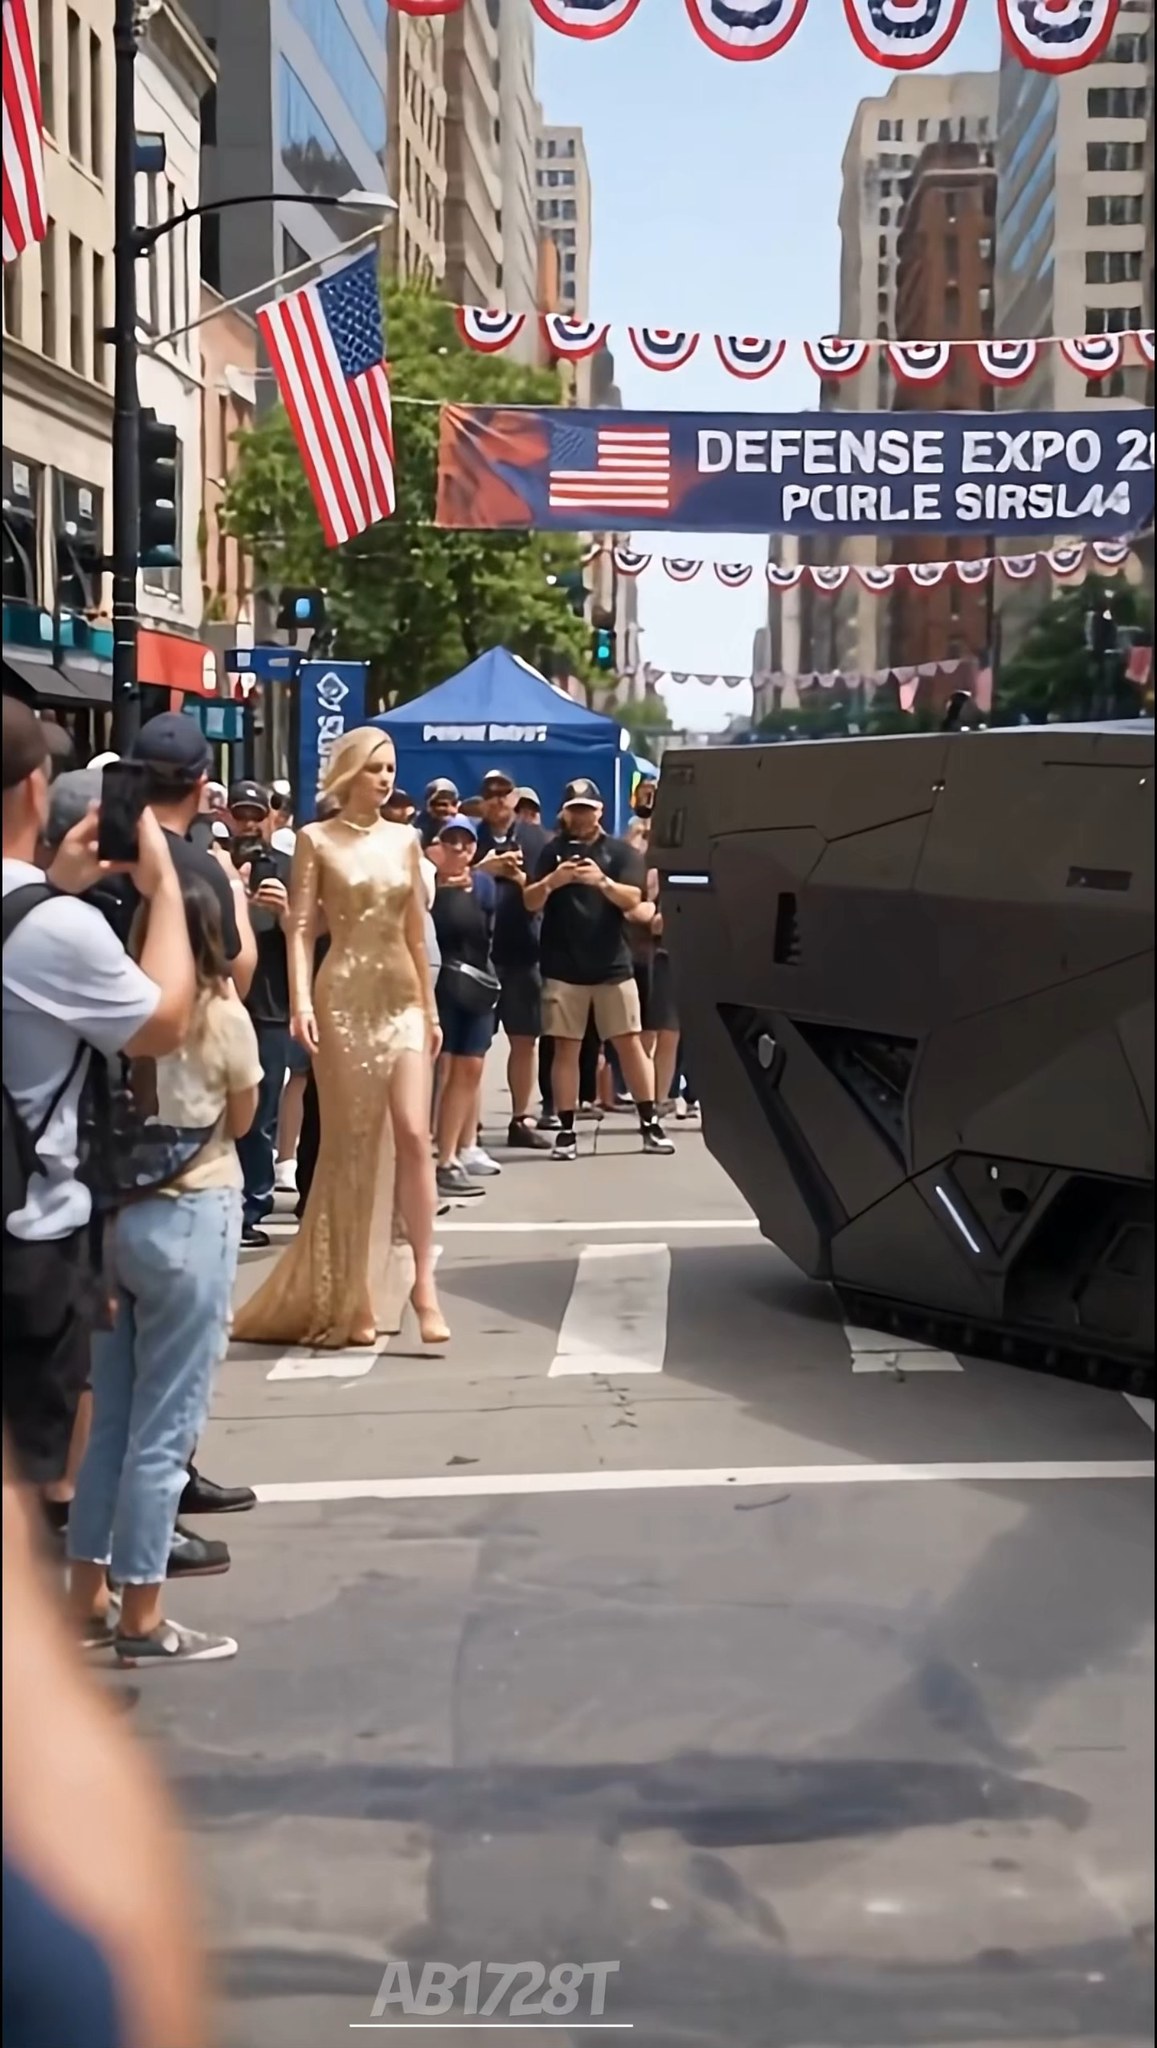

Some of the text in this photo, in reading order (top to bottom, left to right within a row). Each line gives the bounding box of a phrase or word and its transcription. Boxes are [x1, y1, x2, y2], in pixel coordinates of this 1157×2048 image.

[698, 429, 1155, 474] DEFENSE EXPO 2
[783, 484, 942, 521] PCIRLE
